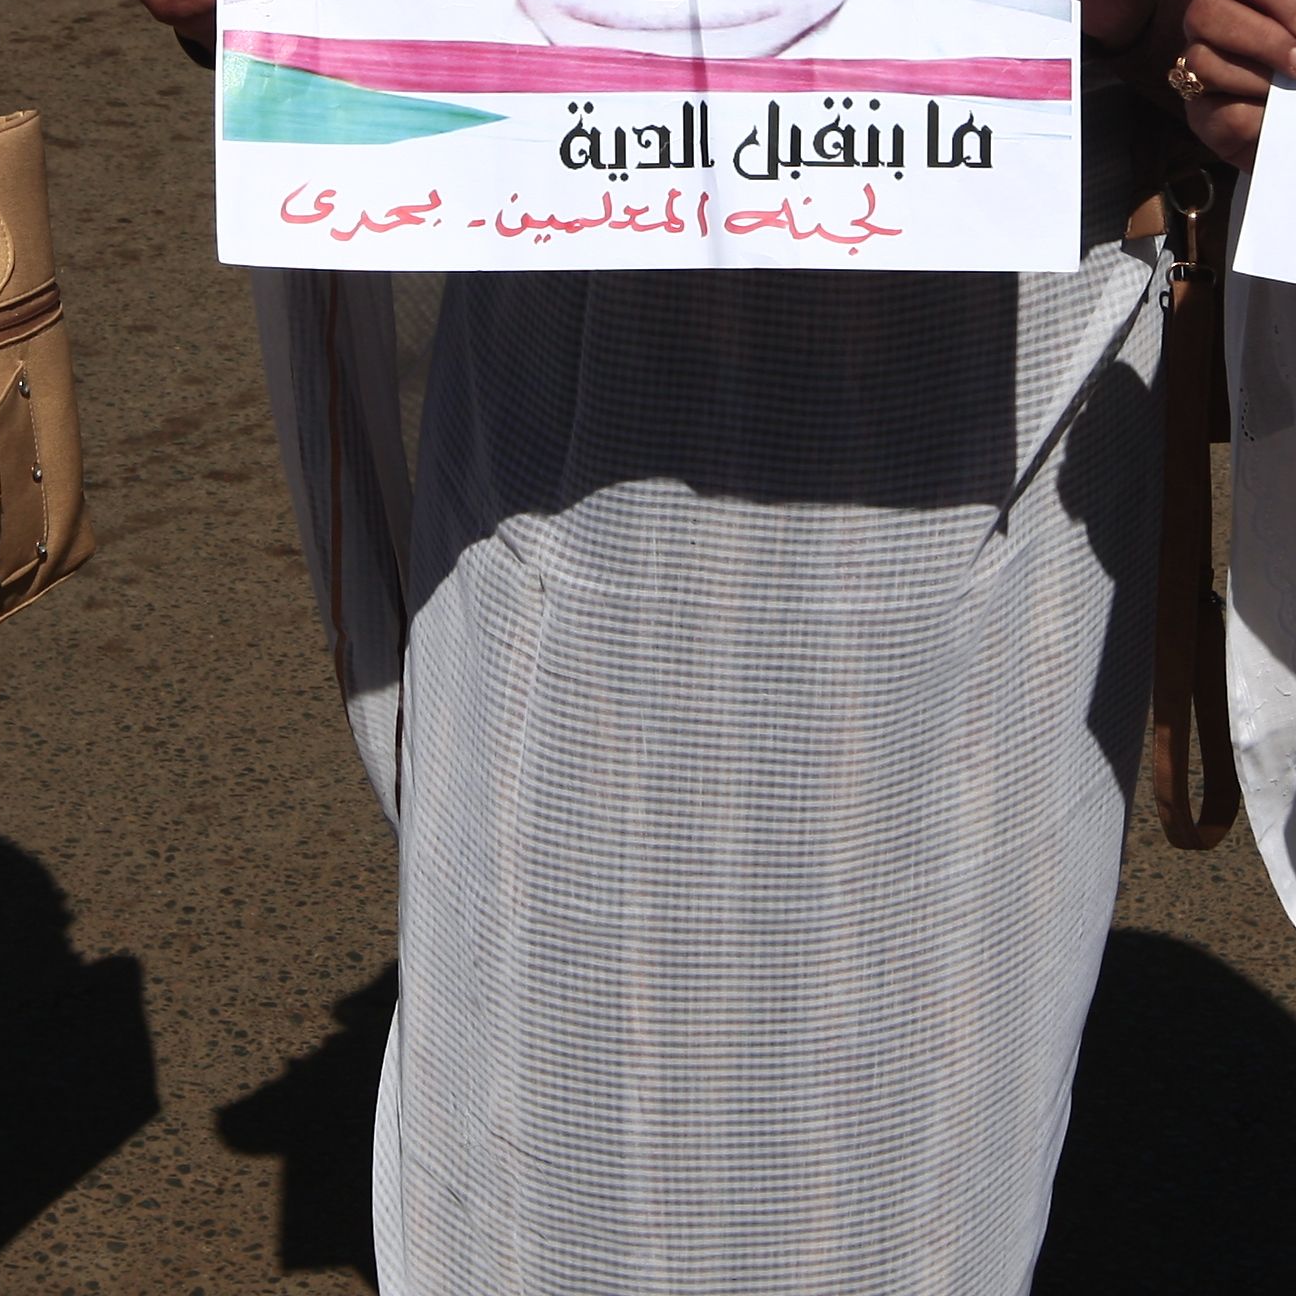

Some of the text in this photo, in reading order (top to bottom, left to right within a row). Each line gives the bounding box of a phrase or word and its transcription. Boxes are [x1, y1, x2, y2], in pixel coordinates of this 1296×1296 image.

[559, 97, 994, 182] ما بنقبل الدية
